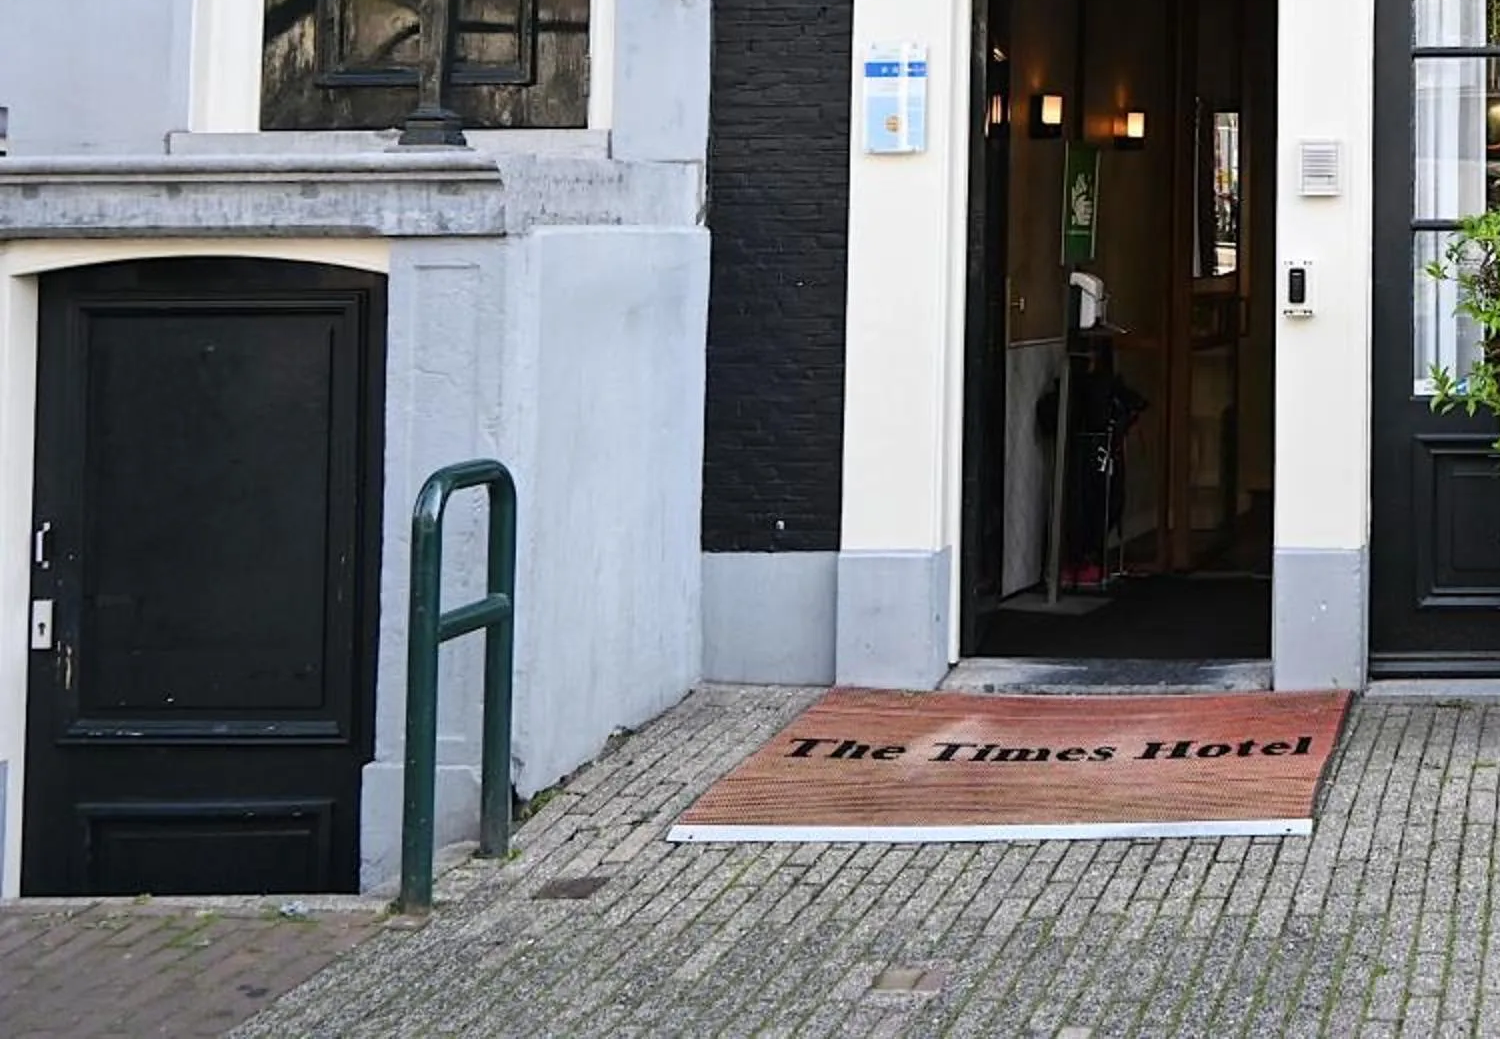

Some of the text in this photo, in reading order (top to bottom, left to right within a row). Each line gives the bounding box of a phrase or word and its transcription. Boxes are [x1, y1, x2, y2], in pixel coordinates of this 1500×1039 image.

[784, 736, 1314, 762] The Times Hotel
